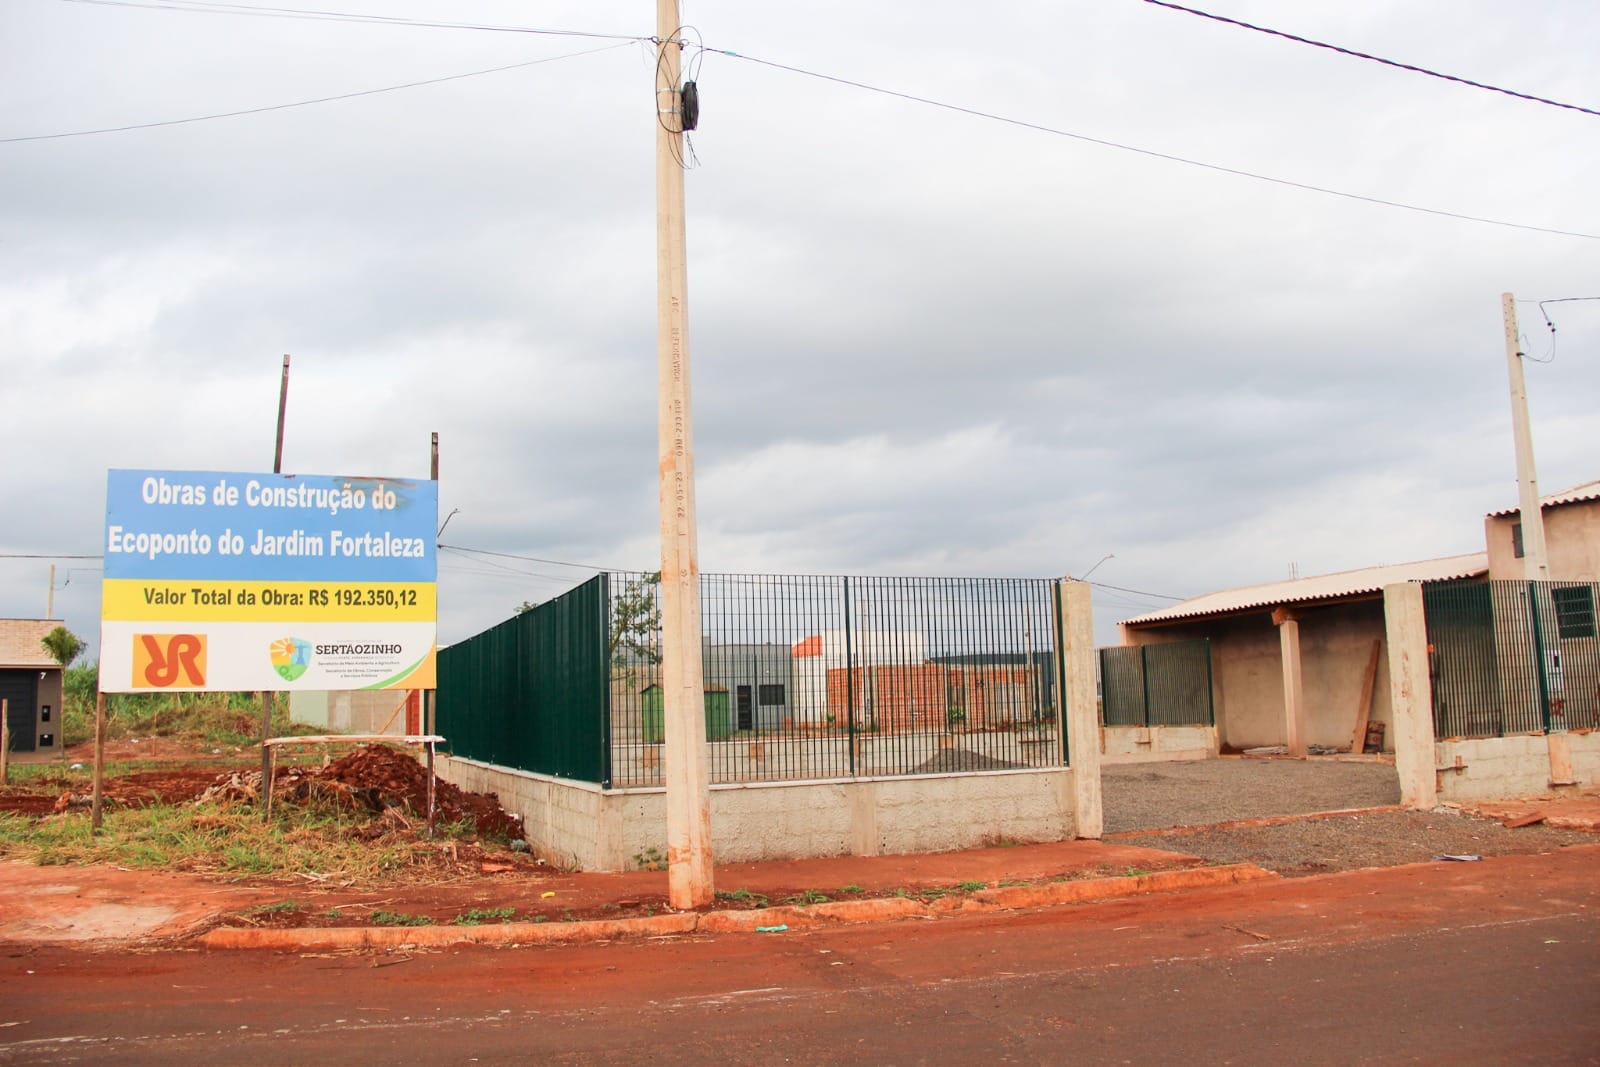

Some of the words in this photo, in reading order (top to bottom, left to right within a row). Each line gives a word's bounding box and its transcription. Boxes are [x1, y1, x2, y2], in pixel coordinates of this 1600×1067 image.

[143, 478, 205, 504] Obras
[213, 480, 238, 505] de
[246, 481, 365, 514] Construção
[372, 485, 395, 509] do
[109, 526, 210, 559] Ecoponto
[219, 530, 243, 554] do
[251, 530, 322, 555] Jardim
[331, 531, 424, 557] Fortaleza
[144, 588, 186, 605] Valor
[191, 588, 231, 605] Total
[237, 589, 256, 605] da
[261, 589, 303, 606] Obra:
[309, 589, 329, 606] R$
[334, 589, 417, 609] 192.350,12
